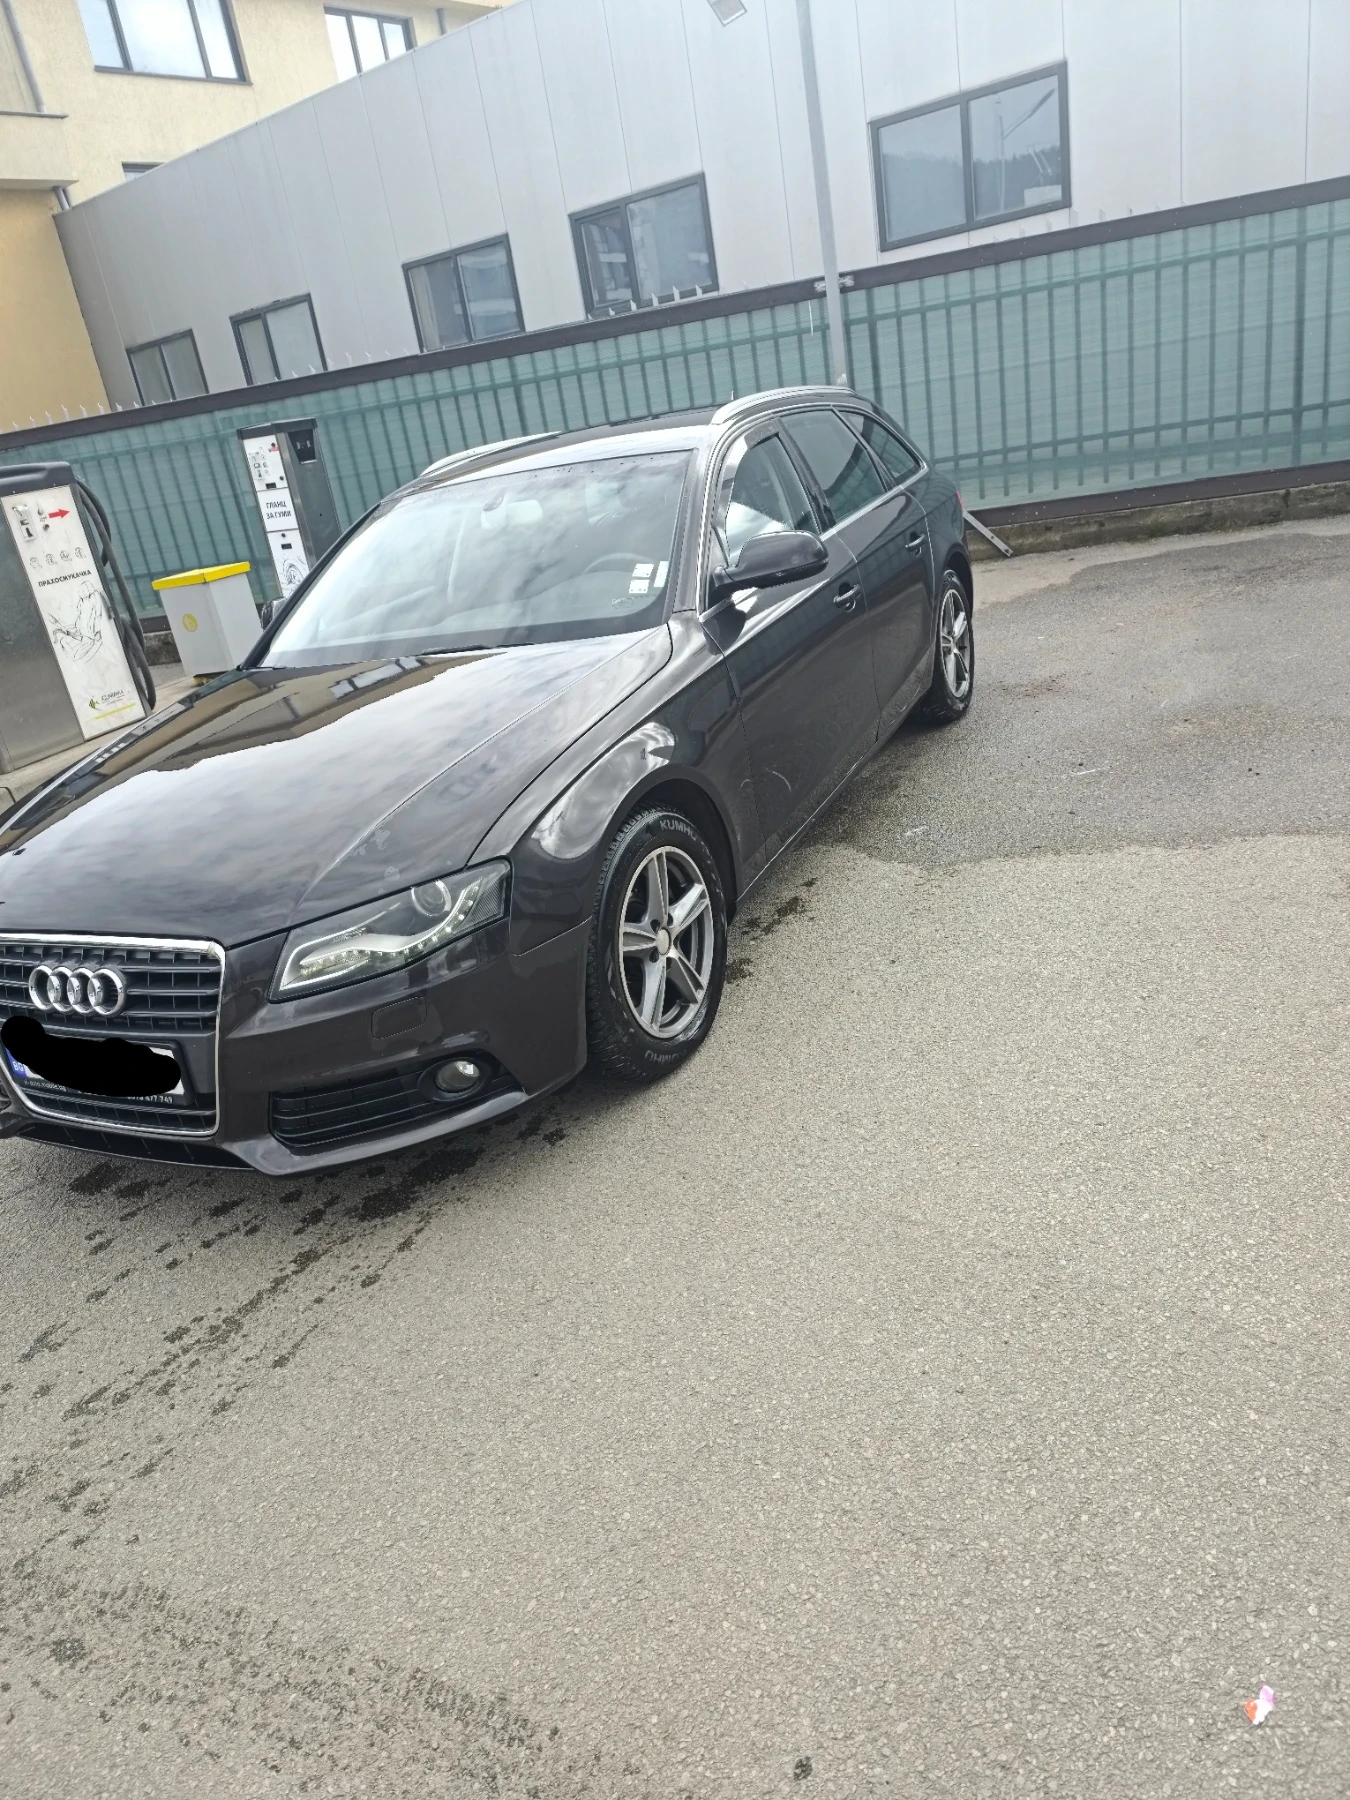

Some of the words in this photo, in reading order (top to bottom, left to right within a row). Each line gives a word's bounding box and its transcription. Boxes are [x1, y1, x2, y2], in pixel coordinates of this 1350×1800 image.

[38, 569, 92, 588] ПРАХОСМУКАЧКА
[660, 819, 698, 842] KUMHO
[13, 1060, 24, 1072] BG
